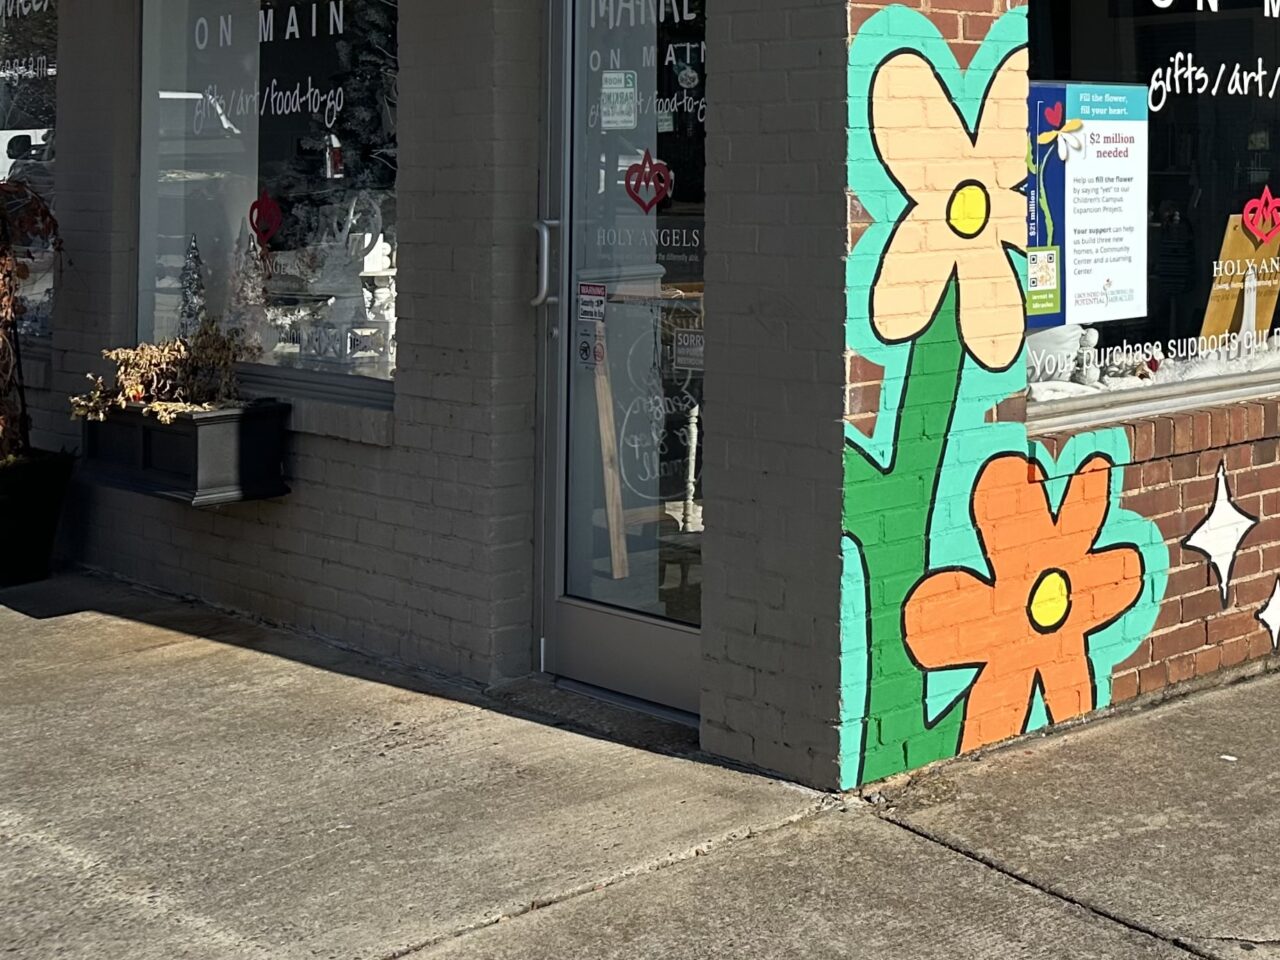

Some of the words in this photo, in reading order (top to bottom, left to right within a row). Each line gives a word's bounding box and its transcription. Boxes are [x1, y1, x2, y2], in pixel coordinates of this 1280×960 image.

[195, 14, 232, 50] ON
[259, 0, 344, 42] MAIN
[589, 48, 620, 72] ON
[1080, 93, 1090, 102] Fill
[1091, 93, 1103, 102] the
[1104, 93, 1128, 104] flower,
[1080, 106, 1090, 115] fill
[1091, 108, 1107, 117] your
[1108, 106, 1128, 115] heart.
[1089, 132, 1101, 144] $2
[1103, 133, 1135, 144] million
[1096, 147, 1129, 158] needed
[1105, 175, 1114, 183] the
[1089, 227, 1112, 235] support
[597, 229, 634, 246] HOLY
[640, 229, 700, 247] ANGELS
[1213, 259, 1256, 277] HOLY
[1032, 349, 1076, 376] Your
[1083, 339, 1162, 370] purchase
[1168, 329, 1238, 360] supports
[1244, 328, 1269, 350] our
